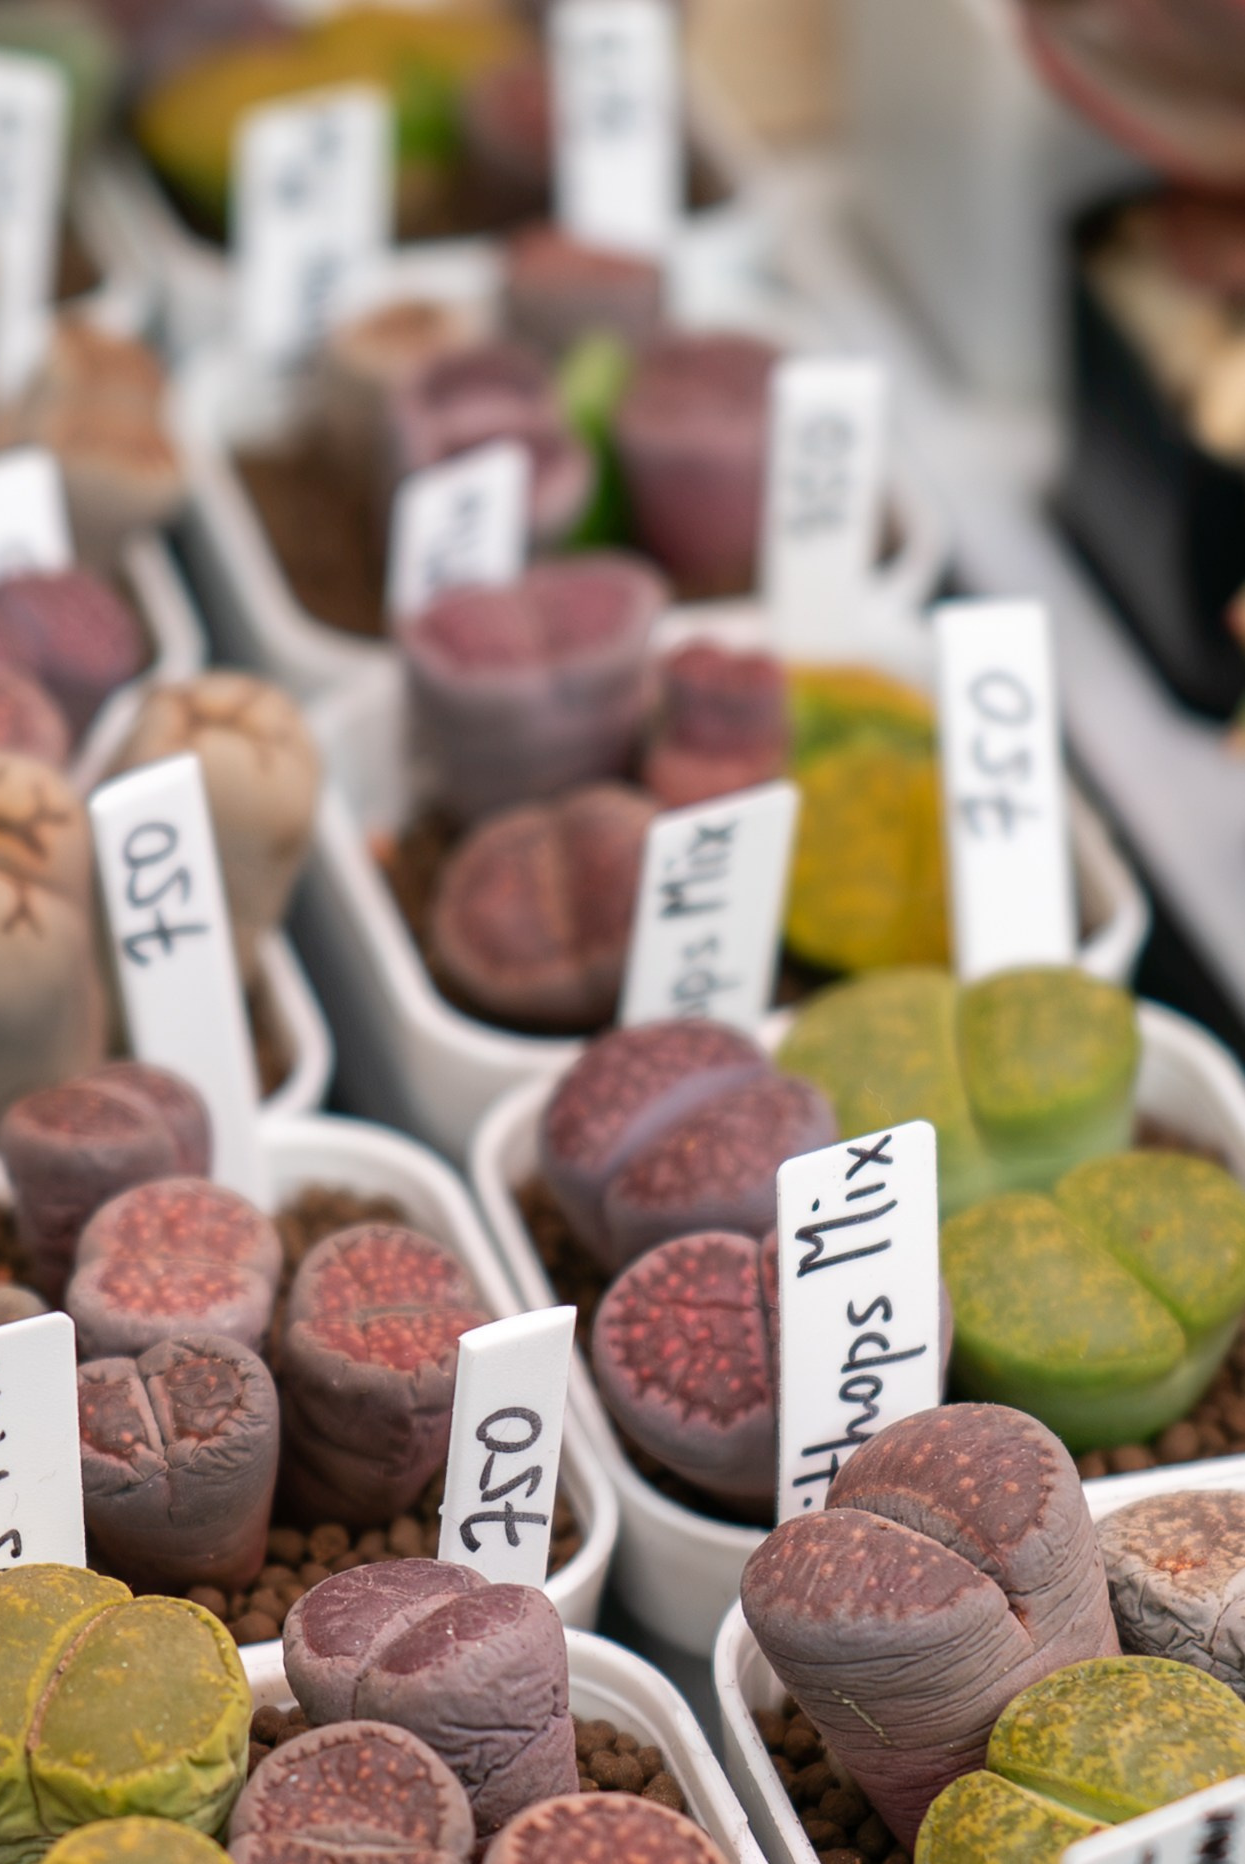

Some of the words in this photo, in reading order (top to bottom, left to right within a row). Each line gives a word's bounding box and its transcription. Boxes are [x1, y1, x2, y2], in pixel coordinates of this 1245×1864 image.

[961, 670, 1038, 840] 750
[121, 820, 212, 970] 750
[656, 818, 740, 922] Mix
[795, 1133, 898, 1278] Mix
[792, 1294, 927, 1508] thops
[458, 1405, 551, 1554] 750
